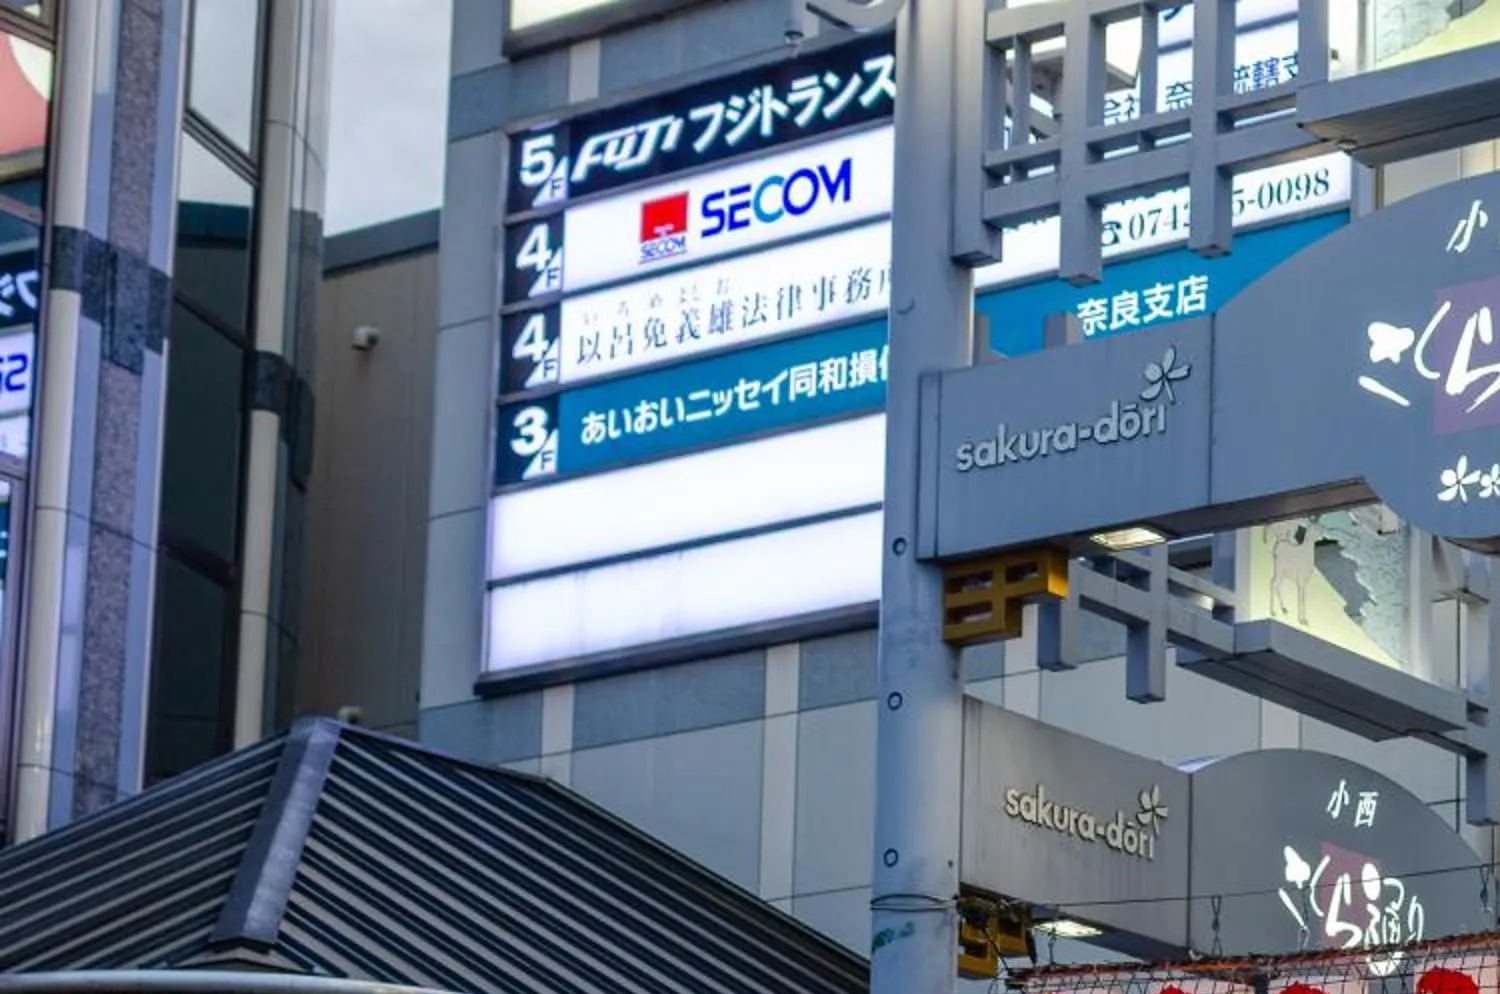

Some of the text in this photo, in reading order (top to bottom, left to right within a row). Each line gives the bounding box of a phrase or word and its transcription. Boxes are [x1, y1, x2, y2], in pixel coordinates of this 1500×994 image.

[701, 158, 852, 238] SECOM
[1077, 277, 1208, 337] 奈良支店
[1326, 778, 1379, 828] 小西
